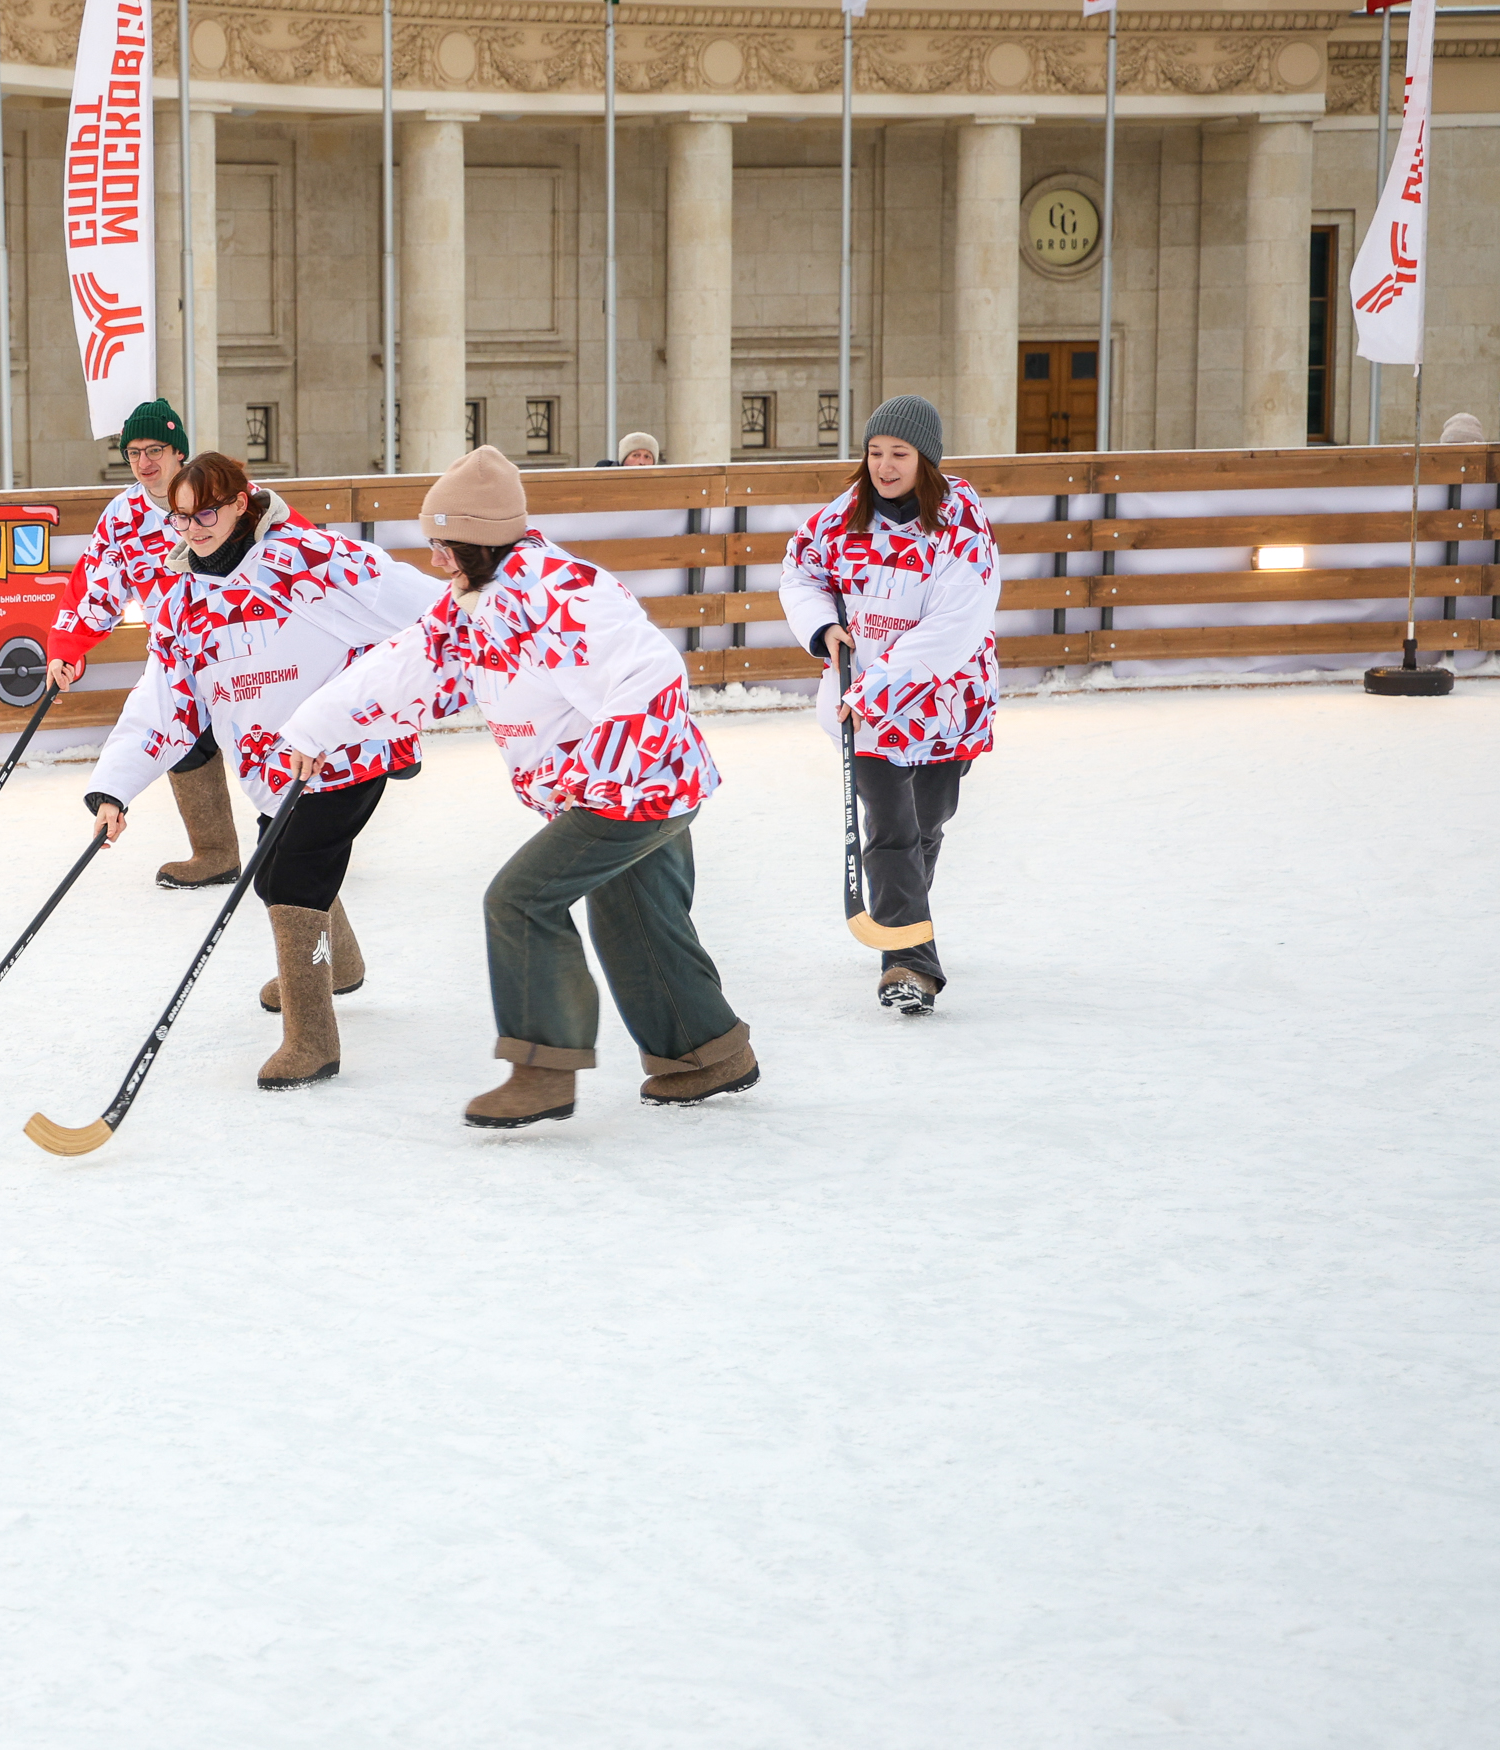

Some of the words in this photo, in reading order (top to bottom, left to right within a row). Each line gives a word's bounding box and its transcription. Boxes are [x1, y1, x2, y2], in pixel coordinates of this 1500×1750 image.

[68, 95, 103, 248] СПОРТ
[1036, 238, 1089, 251] GROUP
[22, 593, 56, 603] СПОНСОР
[864, 626, 889, 642] СПОРТ
[231, 664, 299, 689] МОСКОВСКИЙ
[233, 686, 262, 702] СПОРТ
[844, 769, 852, 806] ORANGE
[847, 855, 858, 892] STEX
[167, 977, 194, 1022] ORANGE
[192, 954, 208, 978] HAIL
